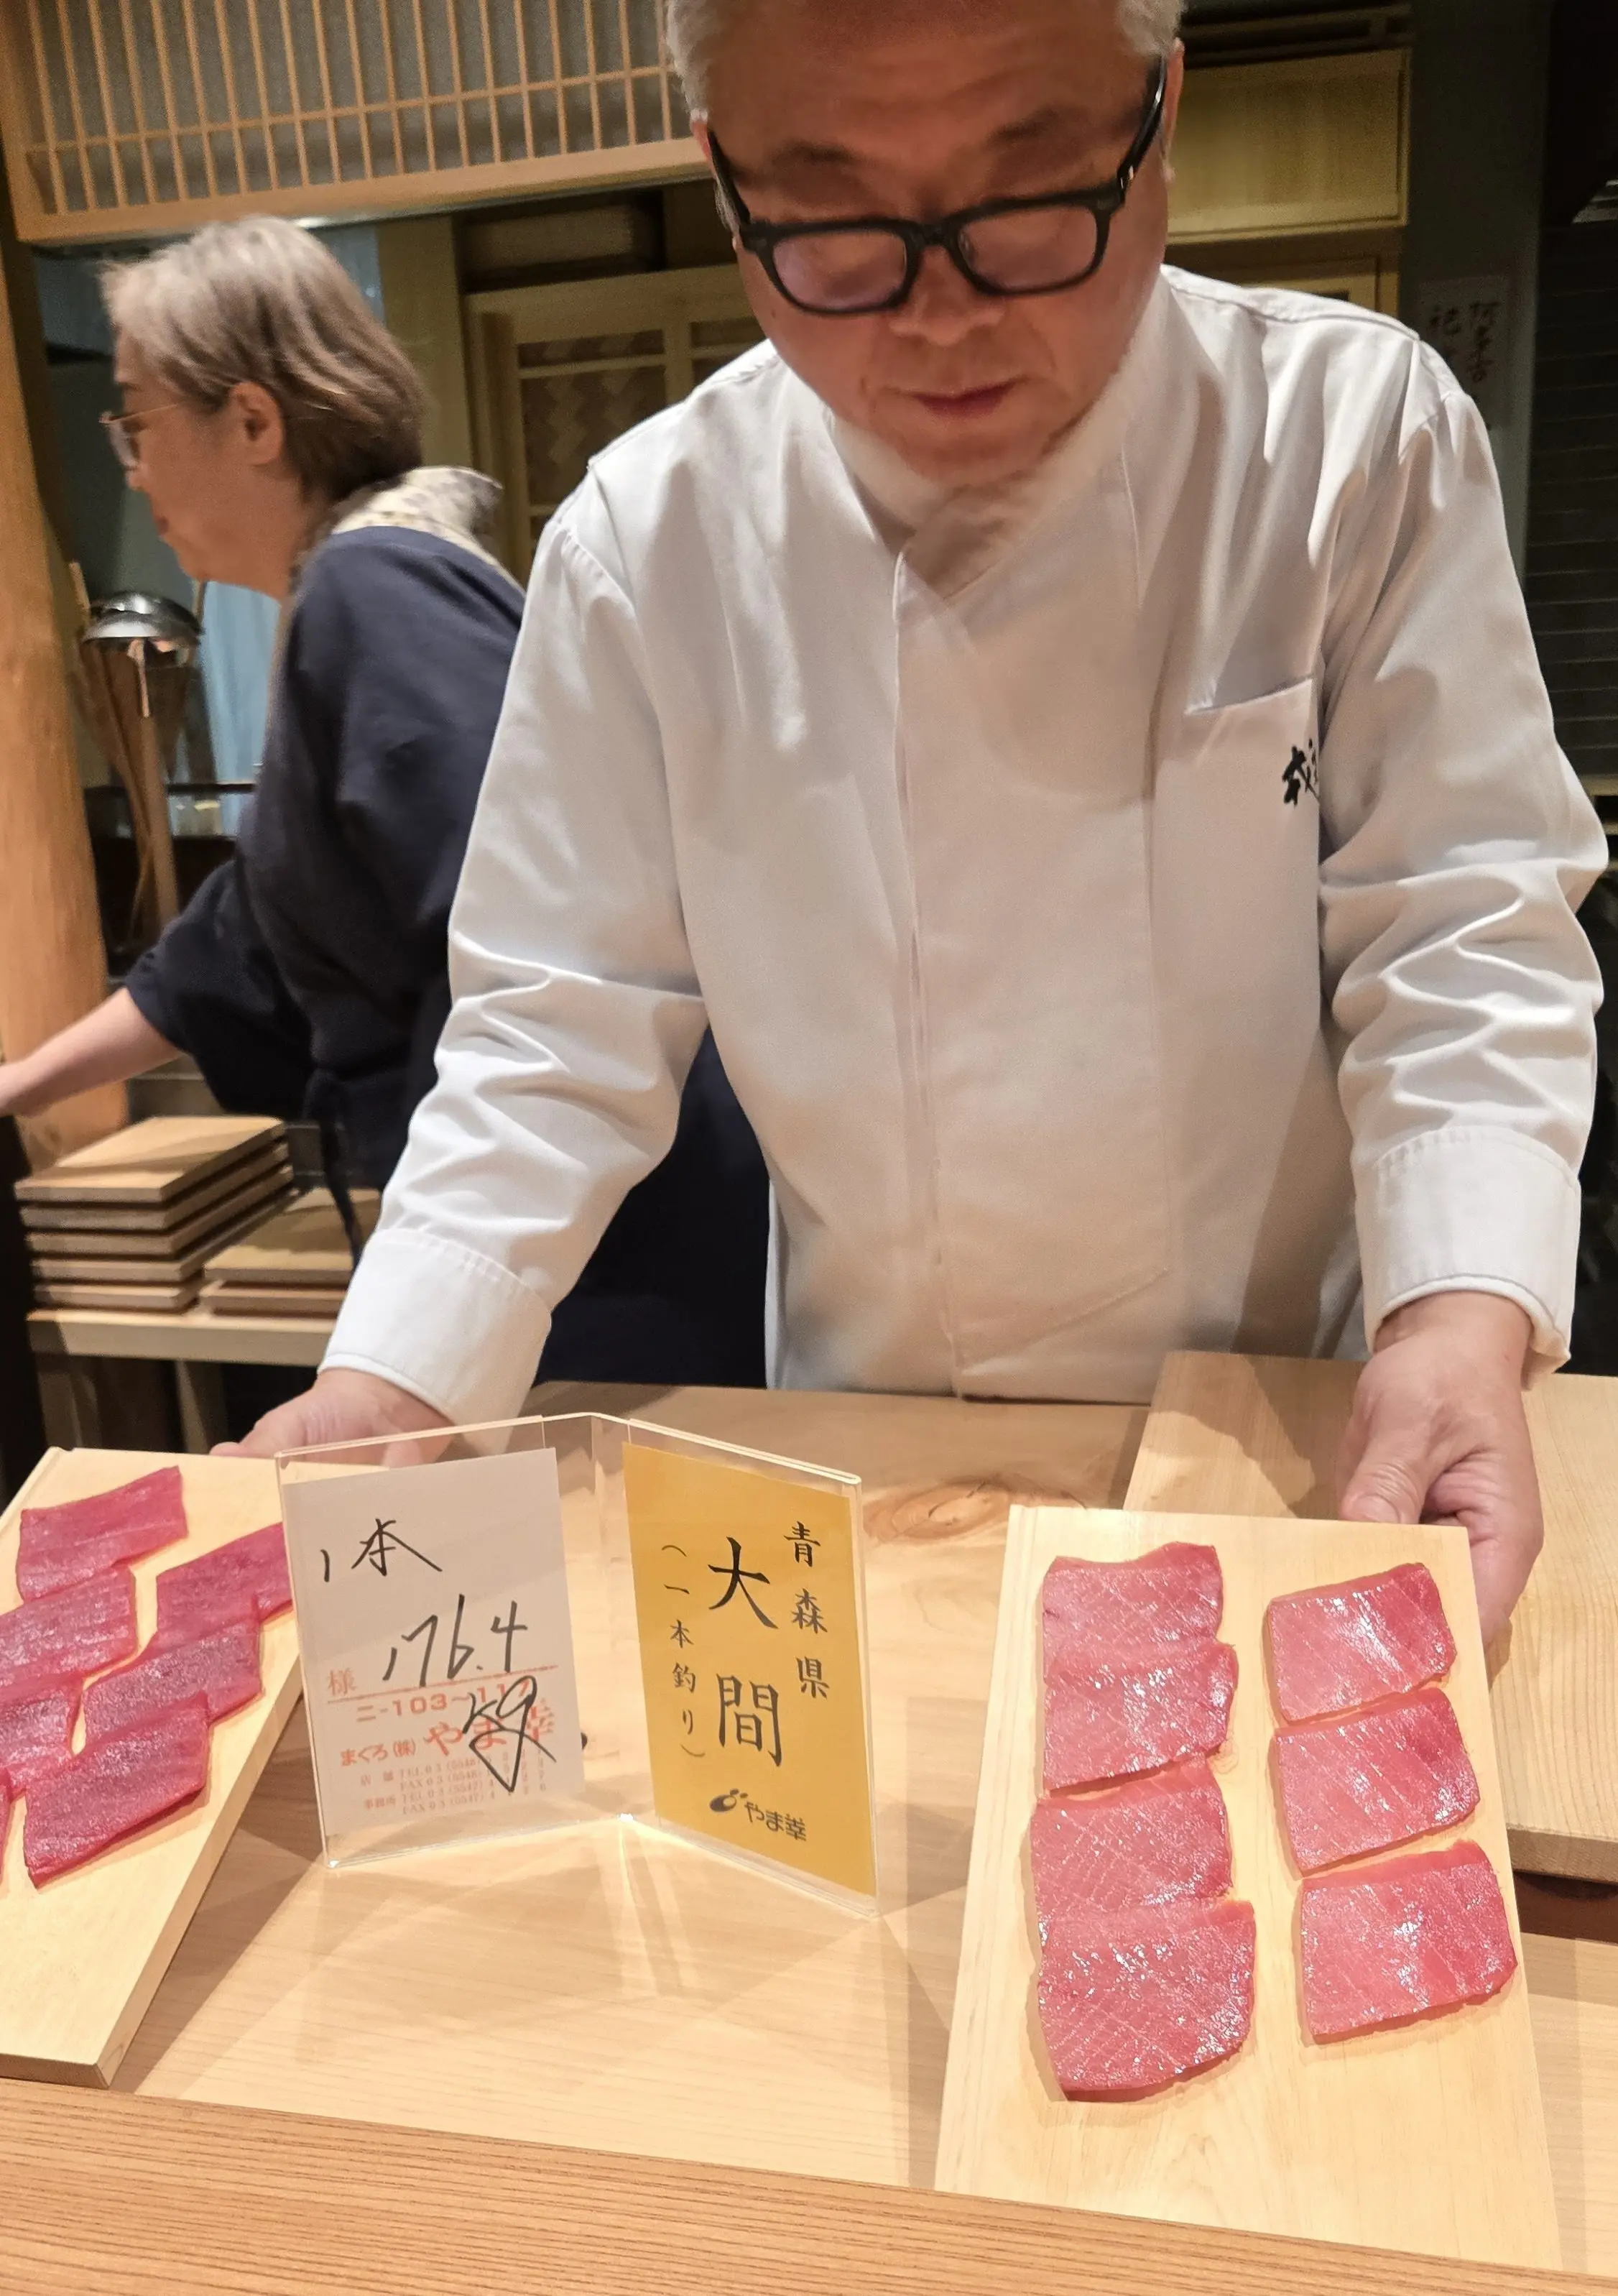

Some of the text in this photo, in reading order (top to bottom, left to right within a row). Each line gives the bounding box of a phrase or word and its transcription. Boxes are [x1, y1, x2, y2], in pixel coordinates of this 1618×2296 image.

[383, 1593, 528, 1688] 176.4
[708, 1536, 783, 1767] 大間
[783, 1521, 831, 1700] 青森県
[328, 1666, 356, 1696] 様
